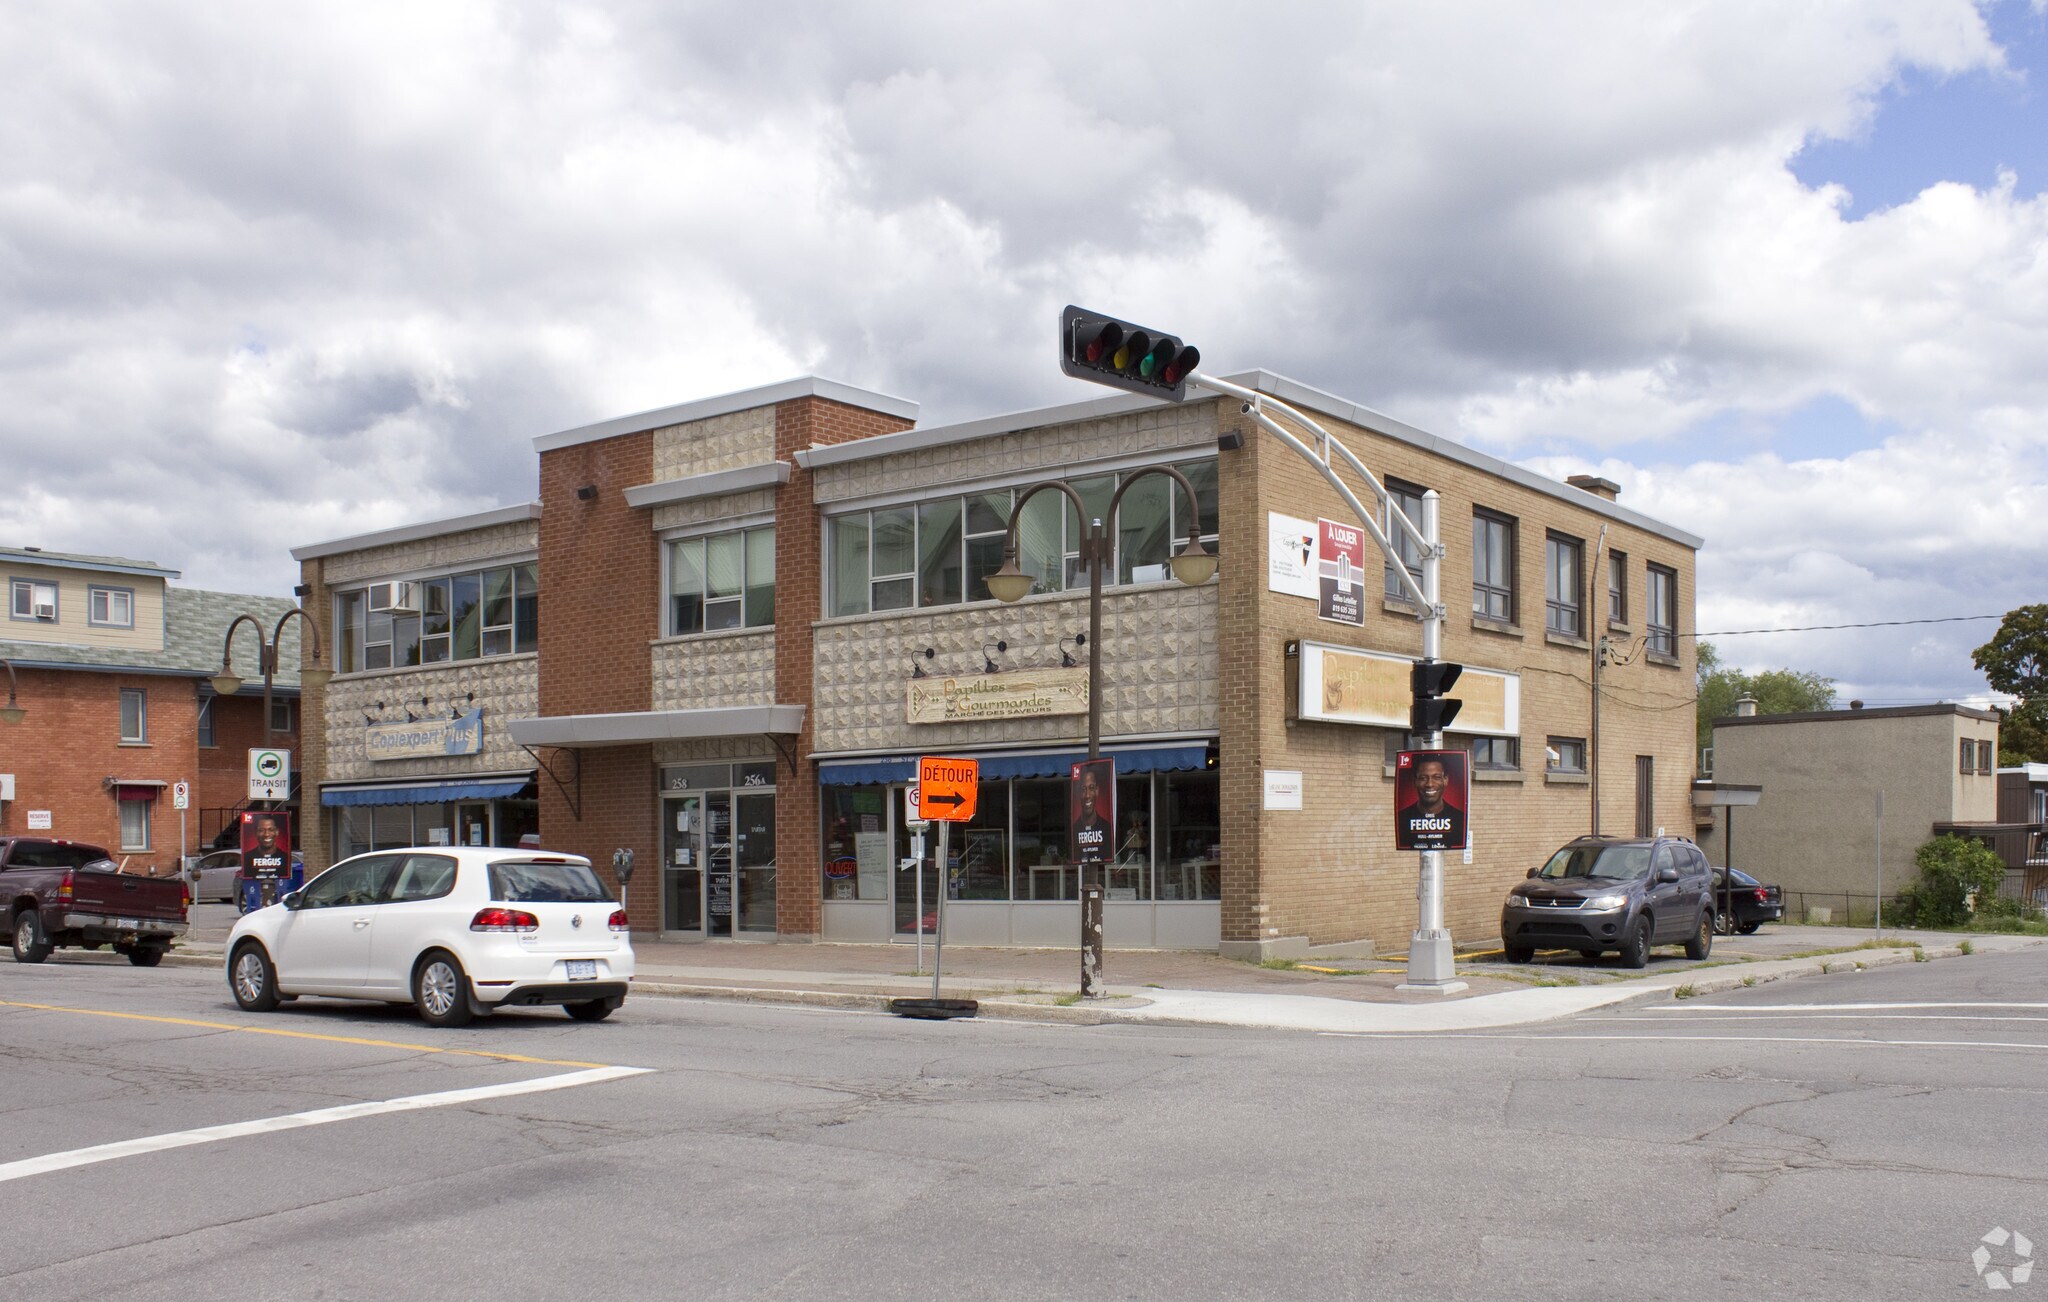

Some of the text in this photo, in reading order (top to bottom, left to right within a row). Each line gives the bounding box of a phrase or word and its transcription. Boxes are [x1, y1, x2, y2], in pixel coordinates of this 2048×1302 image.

[1334, 527, 1358, 546] LOUER
[944, 678, 1006, 700] Papilles
[958, 693, 1052, 714] Gourmandes
[944, 710, 985, 719] MARCHÉ
[1007, 707, 1052, 715] SAVEURS
[371, 728, 440, 752] Copiexpert
[924, 765, 973, 783] DÉTOUR
[251, 779, 288, 788] TRANSIT
[672, 778, 688, 790] 258
[1410, 818, 1451, 831] FERGUS
[1078, 830, 1103, 844] FERGUS
[253, 858, 281, 867] FERGUS
[825, 861, 857, 875] OUVERT
